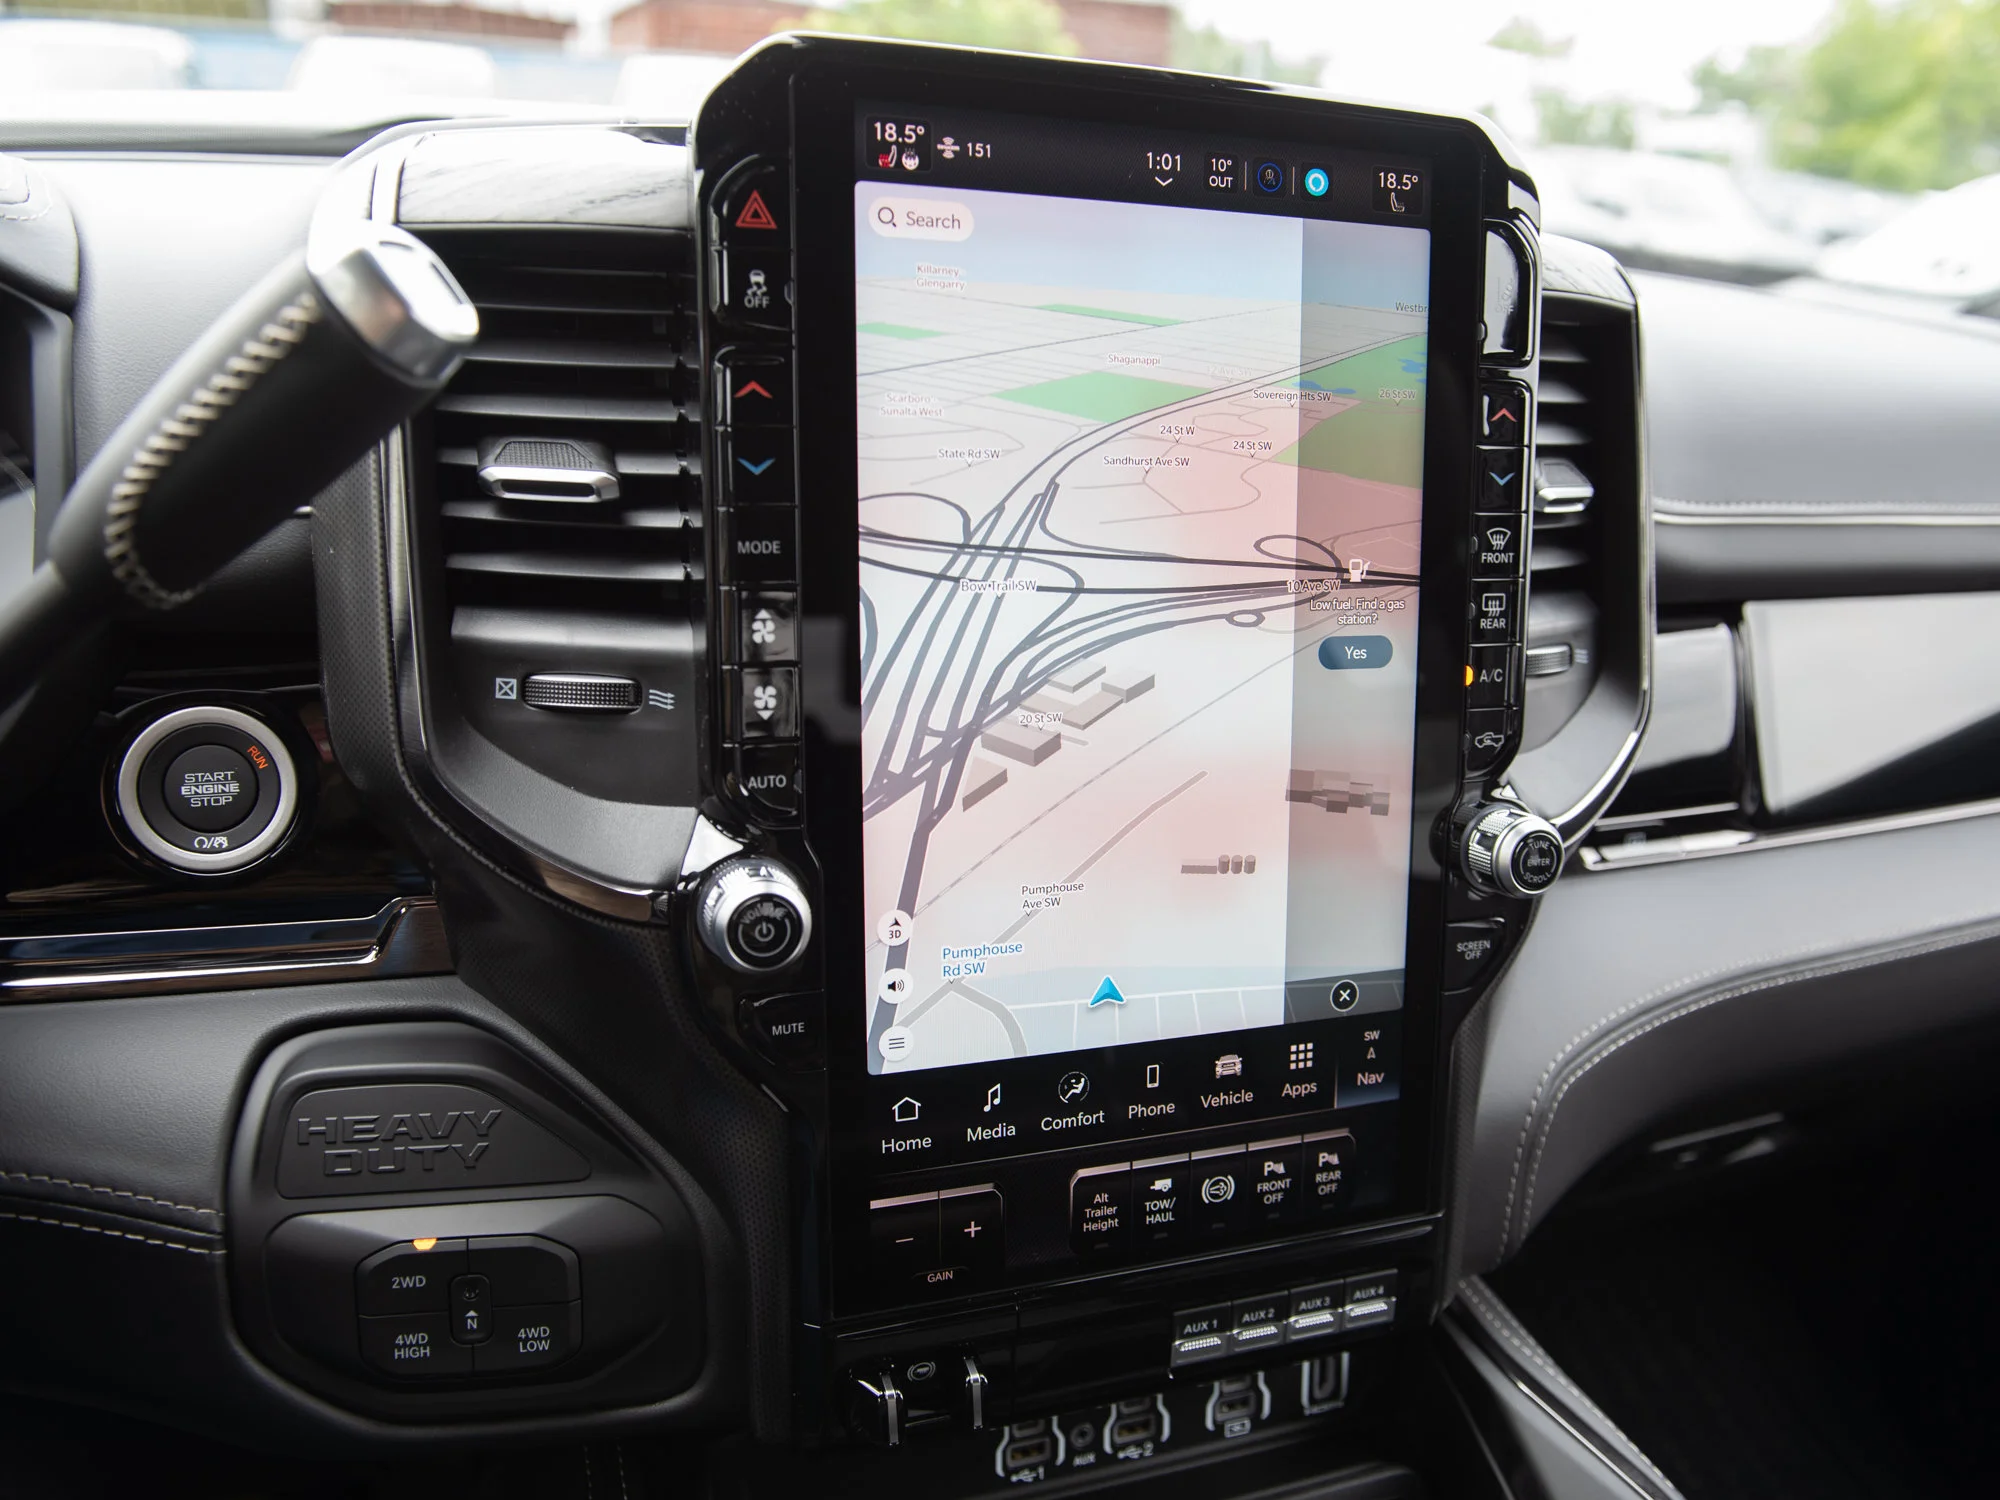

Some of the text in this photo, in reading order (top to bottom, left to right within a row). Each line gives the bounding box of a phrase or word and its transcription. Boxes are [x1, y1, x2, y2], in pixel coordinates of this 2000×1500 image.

[966, 142, 992, 159] 151
[1146, 152, 1182, 172] 1:01
[1211, 158, 1233, 172] 10°
[1209, 175, 1233, 189] OUT
[905, 210, 961, 231] Search
[916, 277, 966, 292] Glengarry
[743, 295, 770, 309] OFF
[1395, 301, 1428, 313] Westbr
[1107, 354, 1161, 367] Shaganappi
[1252, 389, 1332, 402] Sovereign Hts SW
[1379, 389, 1417, 399] 26 St SW
[880, 406, 943, 418] Sunalta West
[1160, 425, 1195, 436] 24 St W
[1233, 440, 1272, 451] 24 St SW
[938, 448, 1001, 459] State Rd SW
[1103, 455, 1190, 467] Sandhurst Ave SW
[737, 540, 781, 555] MODE
[1481, 552, 1514, 564] FRONT
[961, 580, 1037, 592] Bow Trail SW
[1287, 580, 1341, 592] 10 Ave SW
[1310, 599, 1405, 611] Low fuel. Find a gas
[1337, 613, 1378, 625] station?
[1480, 618, 1506, 630] REAR
[1344, 645, 1367, 660] Yes
[1479, 668, 1503, 683] A/C
[1019, 714, 1063, 724] 20 St SW
[247, 745, 269, 769] RUN
[184, 771, 235, 783] START
[747, 774, 787, 789] AUTO
[180, 783, 240, 795] ENGINE
[190, 795, 233, 808] STOP
[1528, 841, 1550, 851] TUNE
[1523, 871, 1552, 885] SCROLL
[1021, 881, 1085, 897] Pumphouse
[1022, 897, 1061, 910] Ave SW
[888, 929, 902, 940] 3D
[942, 942, 1023, 961] Pumphouse
[1456, 940, 1491, 953] SCREEN
[1464, 951, 1482, 961] OFF
[942, 962, 986, 978] Rd SW
[771, 1021, 805, 1037] MUTE
[1363, 1029, 1381, 1041] SW
[1356, 1071, 1385, 1086] Nav
[1281, 1081, 1318, 1099] Apps
[1200, 1089, 1254, 1109] Vehicle
[1128, 1102, 1176, 1119] Phone
[297, 1109, 502, 1144] HEAVY
[1040, 1110, 1105, 1132] Comfort
[966, 1122, 1016, 1142] Media
[881, 1136, 932, 1154] Home
[324, 1142, 489, 1175] DUTY
[1315, 1170, 1342, 1184] REAR
[1256, 1178, 1292, 1194] FRONT
[1317, 1182, 1338, 1196] OFF
[1093, 1192, 1109, 1204] Alt
[1144, 1197, 1176, 1212] TOW/
[1263, 1192, 1284, 1205] OFF
[1084, 1205, 1118, 1219] Trailer
[1145, 1212, 1175, 1225] HAUL
[1083, 1217, 1119, 1232] Height
[391, 1275, 426, 1289] 2WD
[927, 1270, 954, 1283] GAIN
[1353, 1285, 1385, 1300] AUX 4
[1299, 1296, 1331, 1312] AUX 3
[1241, 1308, 1276, 1323] AUX 2
[466, 1318, 478, 1329] N
[1184, 1318, 1218, 1335] AUX 1
[395, 1332, 428, 1346] 4WD
[517, 1326, 550, 1340] 4WD
[394, 1346, 430, 1360] HIGH
[519, 1339, 550, 1353] LOW
